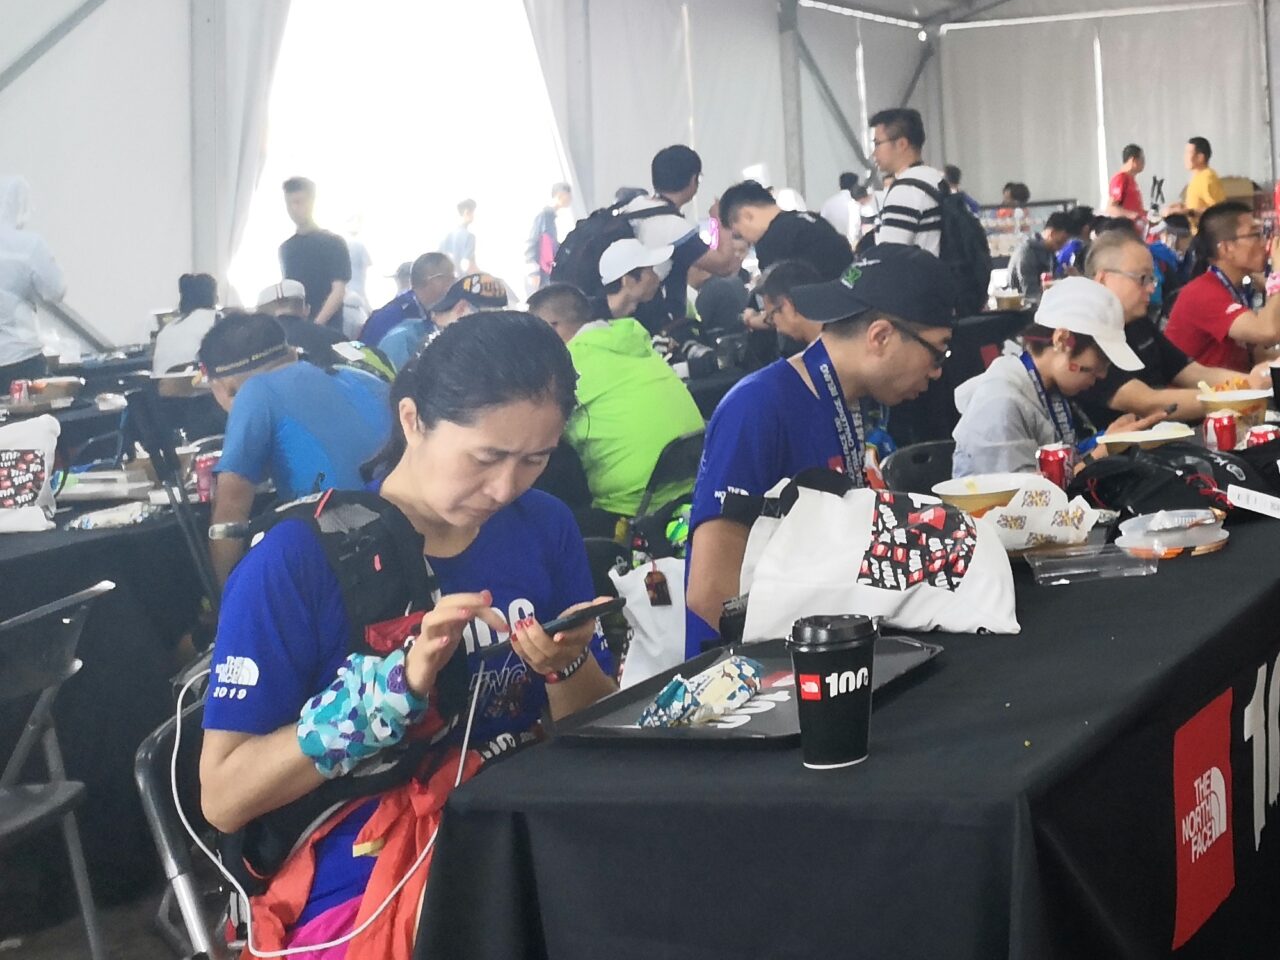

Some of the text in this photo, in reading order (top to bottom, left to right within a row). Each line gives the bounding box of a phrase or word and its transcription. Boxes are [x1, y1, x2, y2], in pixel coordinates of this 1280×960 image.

[825, 667, 869, 698] 100
[1193, 770, 1212, 800] THE
[1181, 795, 1212, 845] NORTH
[1191, 822, 1216, 863] FACE
